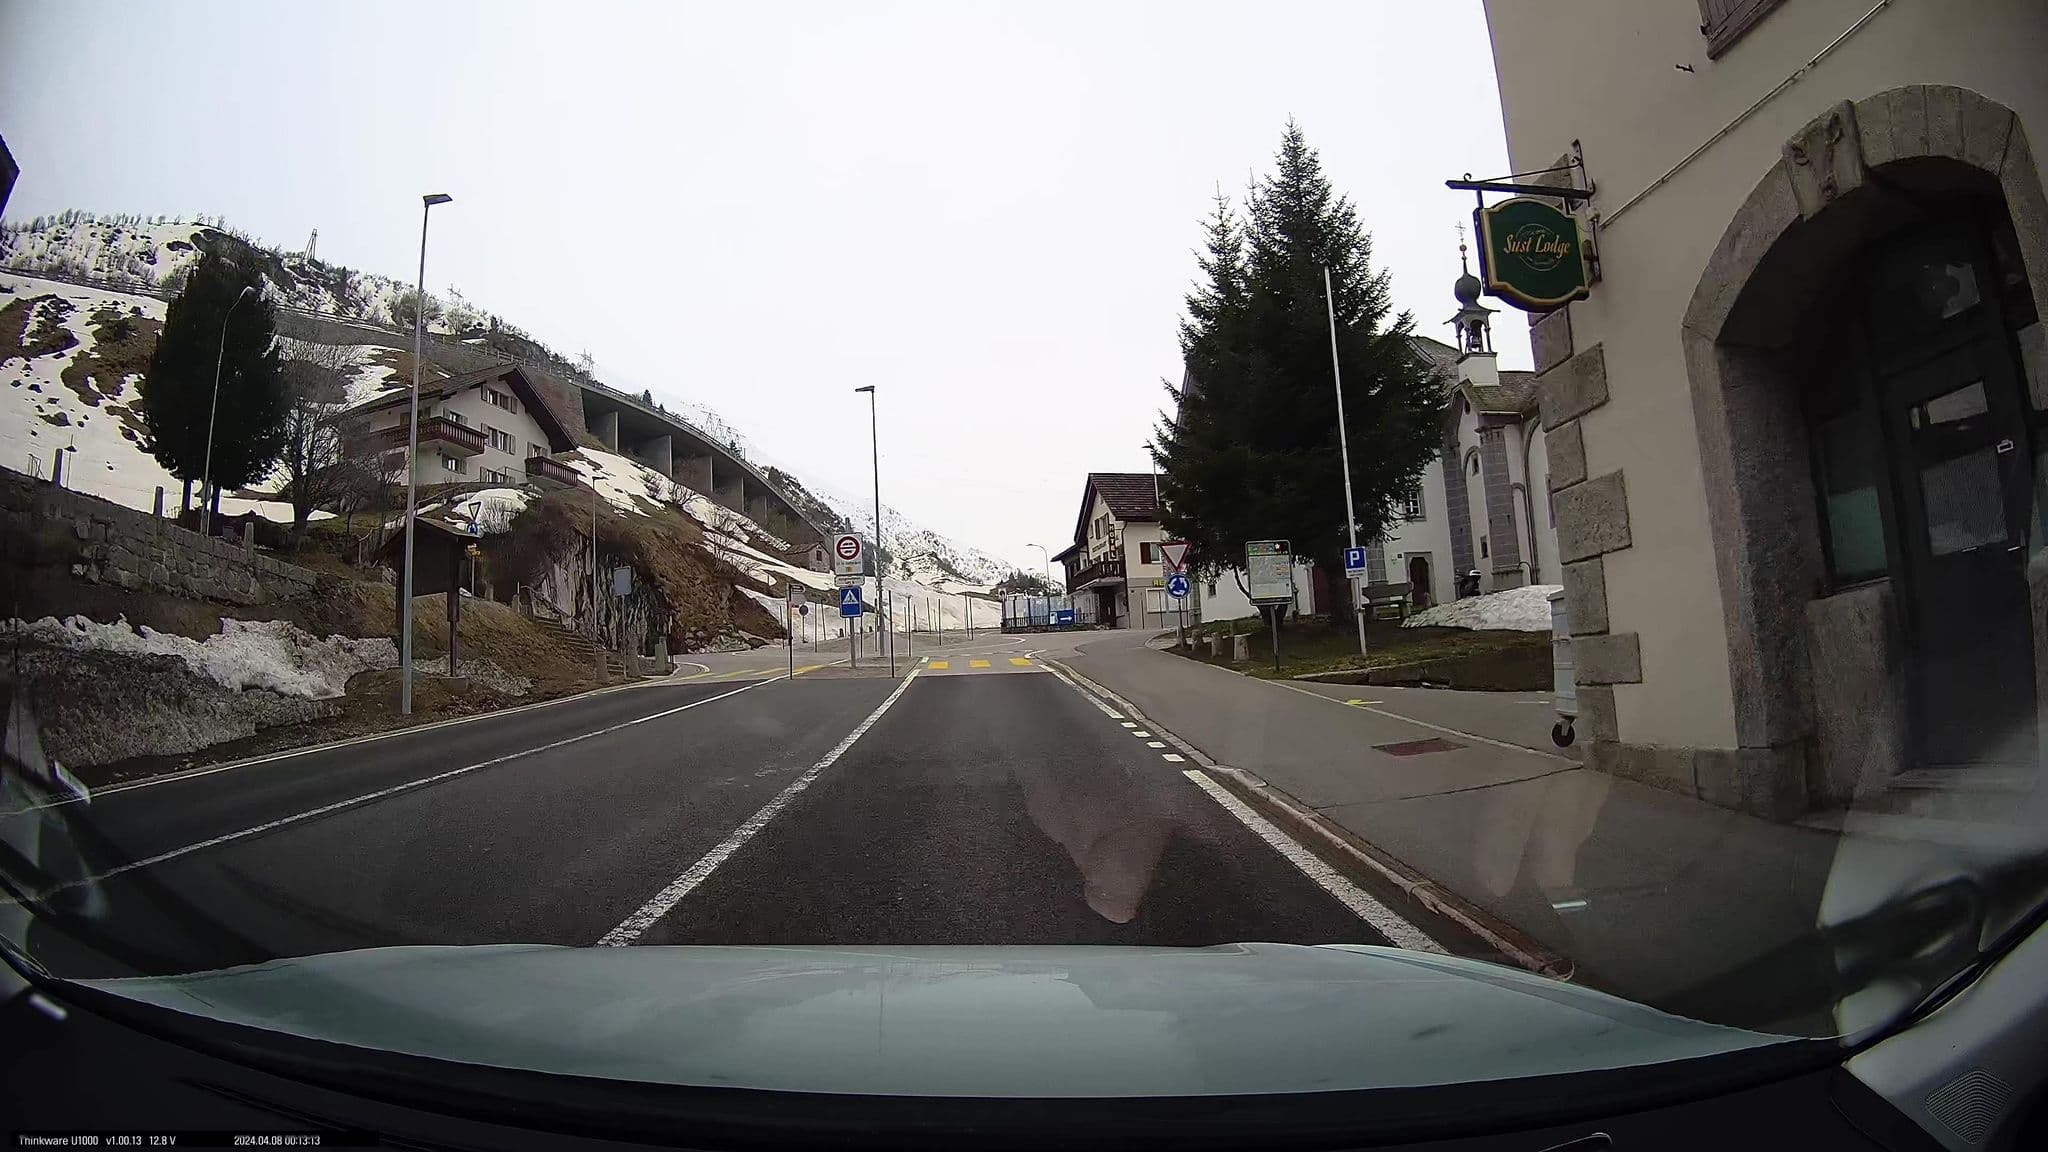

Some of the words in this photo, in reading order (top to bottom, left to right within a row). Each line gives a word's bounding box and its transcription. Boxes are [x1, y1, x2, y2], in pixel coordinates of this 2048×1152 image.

[1503, 233, 1532, 254] Sust
[1535, 233, 1570, 259] Lodge
[1350, 550, 1360, 566] P
